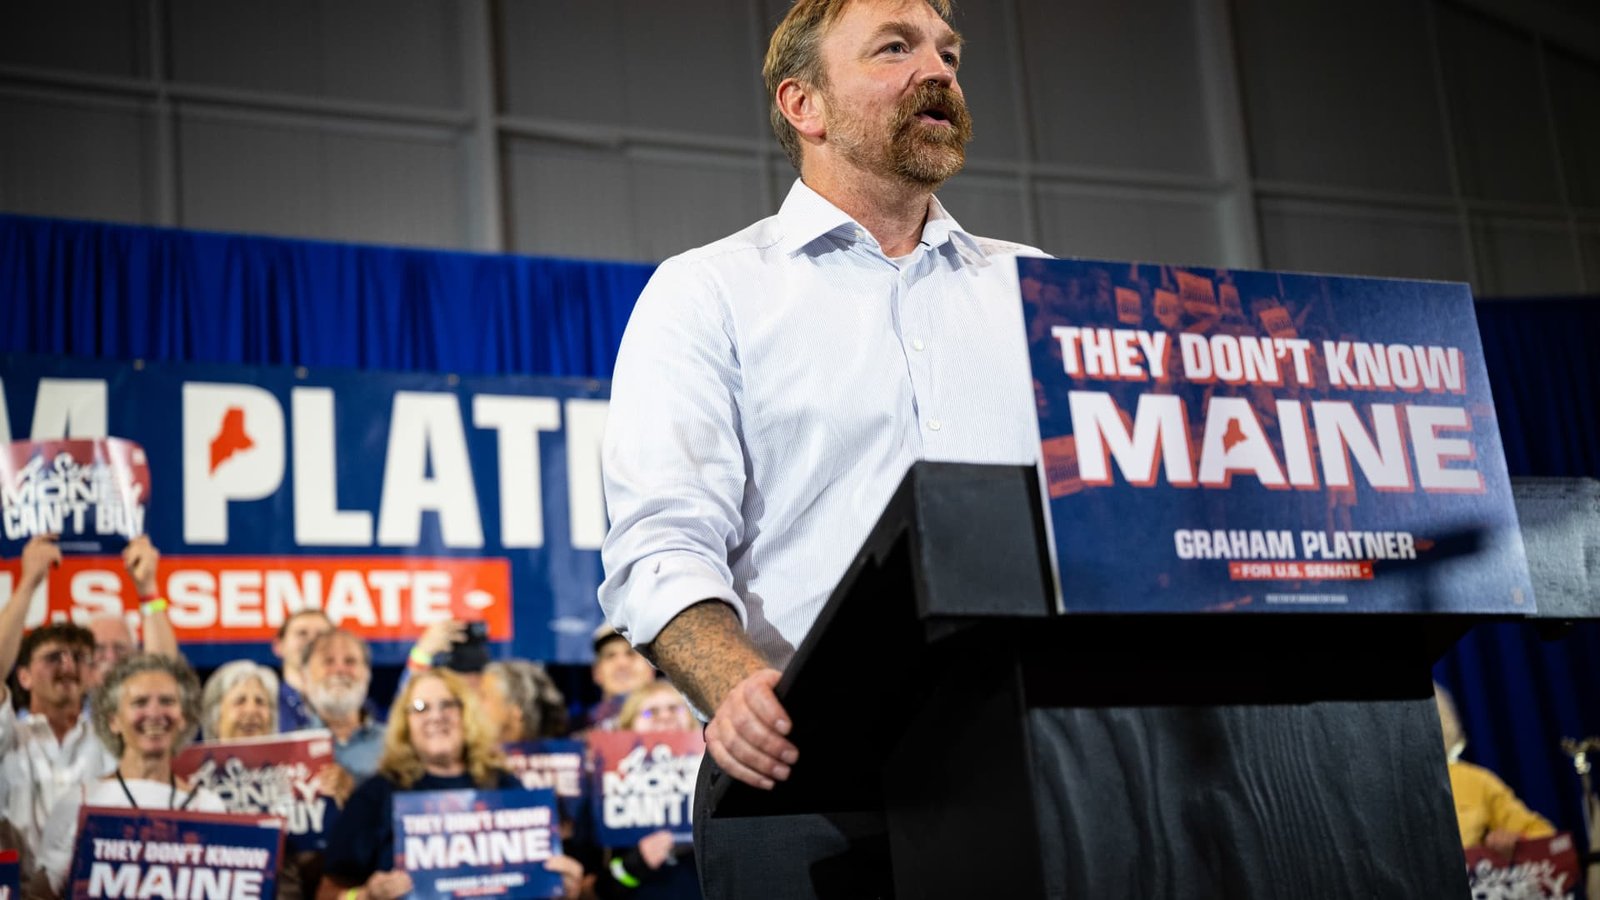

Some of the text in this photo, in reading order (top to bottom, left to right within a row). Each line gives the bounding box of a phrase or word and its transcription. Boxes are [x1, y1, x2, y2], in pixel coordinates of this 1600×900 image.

[1051, 326, 1465, 393] THEY DON'T KNOW
[1067, 389, 1485, 491] MAINE
[182, 381, 609, 551] PLAT
[1174, 529, 1417, 560] GRAHAM PLATNER
[1241, 562, 1362, 578] FOR U.S. SENATE
[166, 569, 453, 628] SENATE
[92, 838, 142, 862] THEY
[404, 827, 553, 871] MAINE
[87, 861, 264, 900] MAINE
